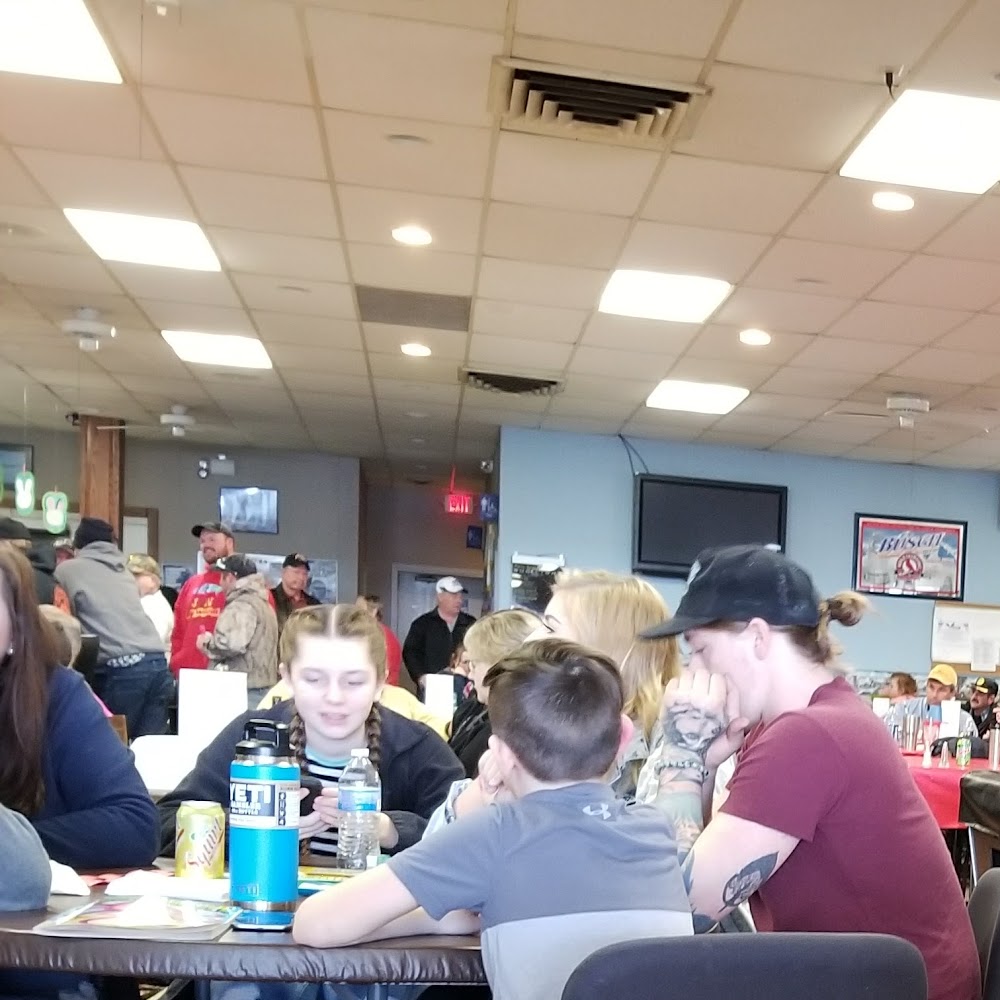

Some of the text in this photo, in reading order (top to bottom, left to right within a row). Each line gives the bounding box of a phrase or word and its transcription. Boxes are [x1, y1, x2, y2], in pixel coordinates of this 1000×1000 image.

[449, 495, 471, 513] EXIT
[877, 530, 946, 553] BUSCH
[230, 783, 271, 804] YETI
